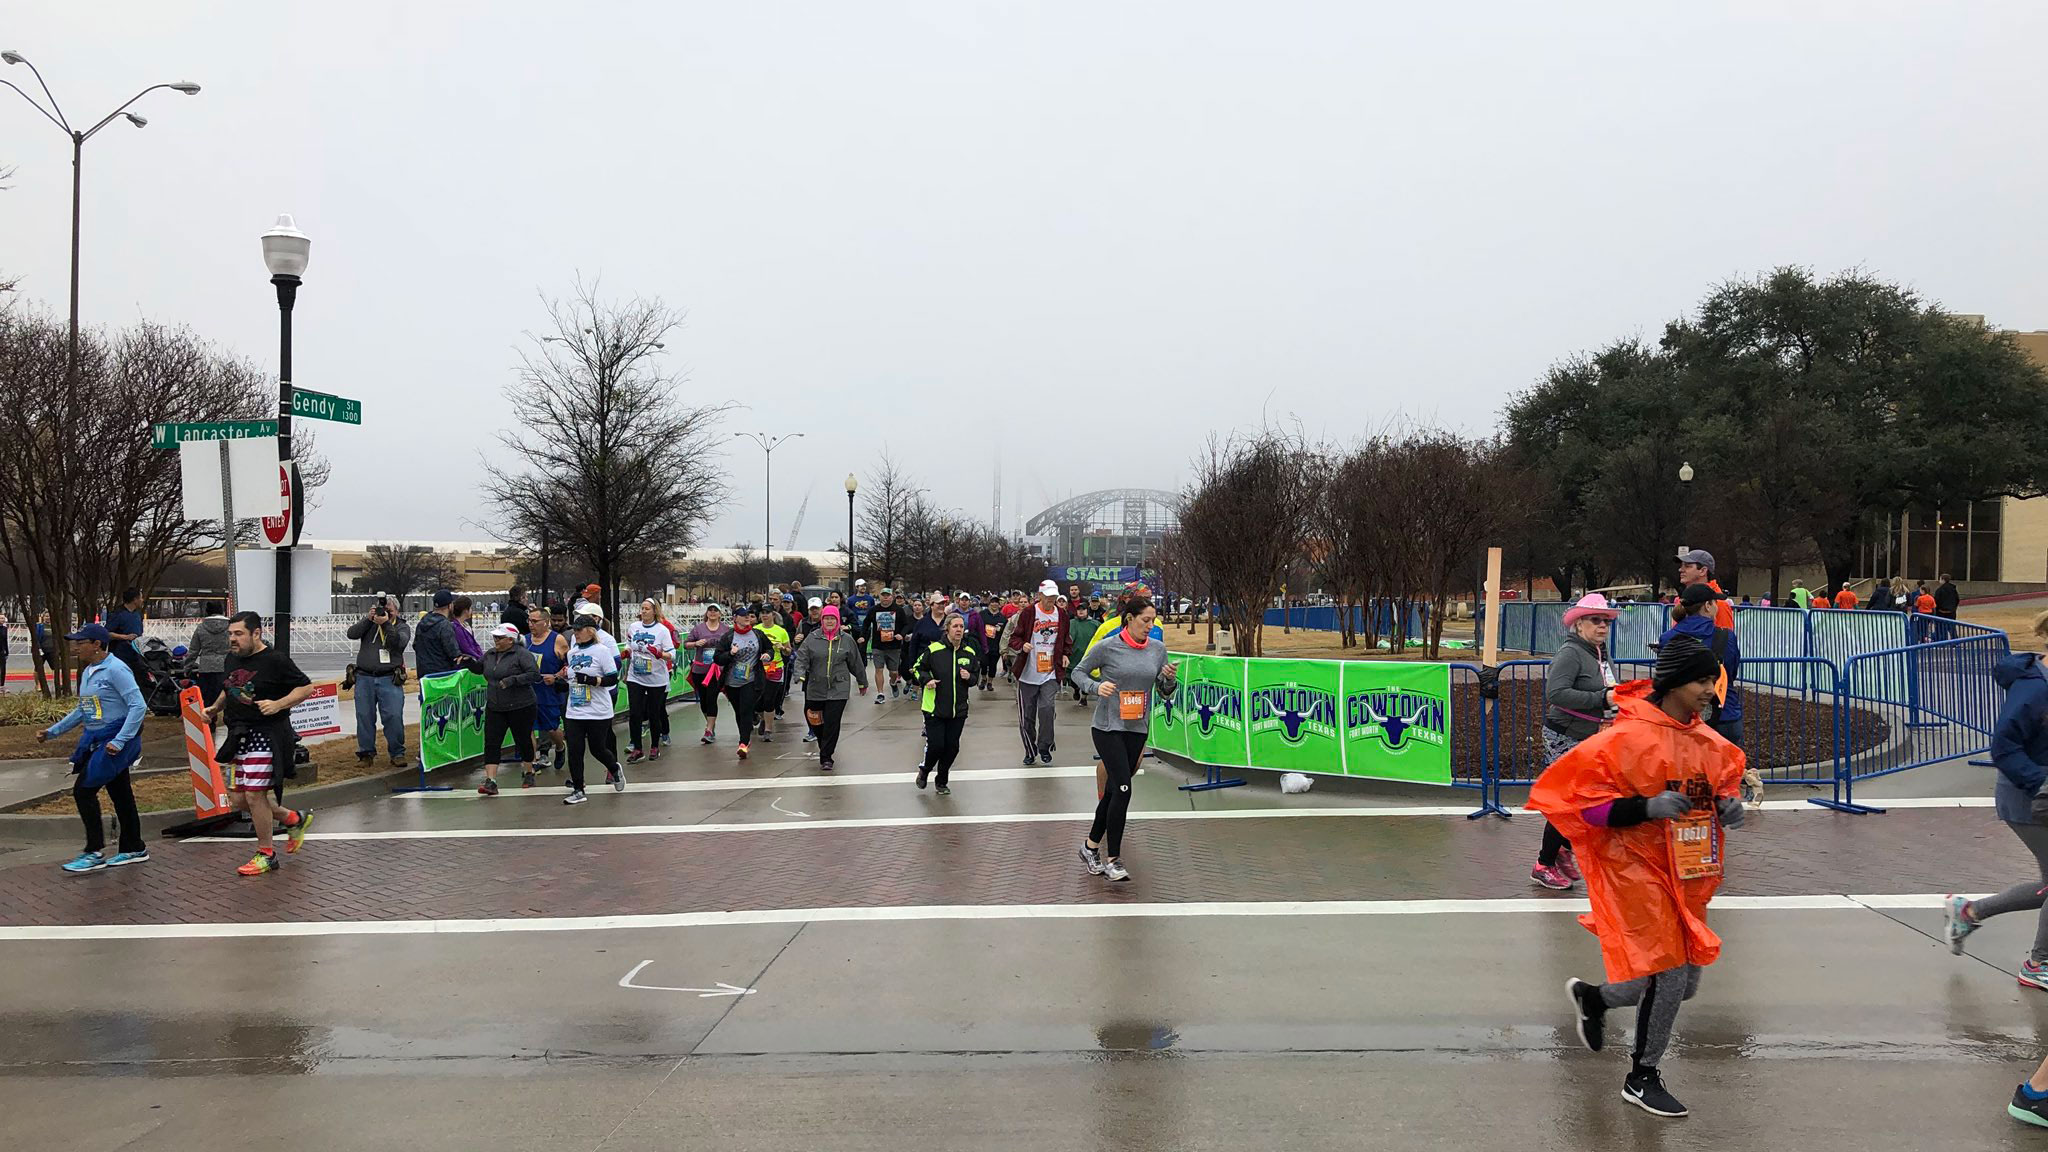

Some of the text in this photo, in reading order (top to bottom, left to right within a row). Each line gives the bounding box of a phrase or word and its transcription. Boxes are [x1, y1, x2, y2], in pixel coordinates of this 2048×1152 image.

[293, 392, 354, 420] Gendy St
[342, 411, 359, 422] 1300
[155, 423, 271, 443] W Lancaster Av
[266, 515, 286, 529] ENTER
[1066, 567, 1121, 581] START
[1251, 688, 1336, 728] COWTOWN
[1347, 693, 1444, 734] COWTOWN
[1216, 715, 1241, 732] TEXAS
[1308, 721, 1336, 737] TEXAS
[1412, 727, 1444, 745] TEXAS
